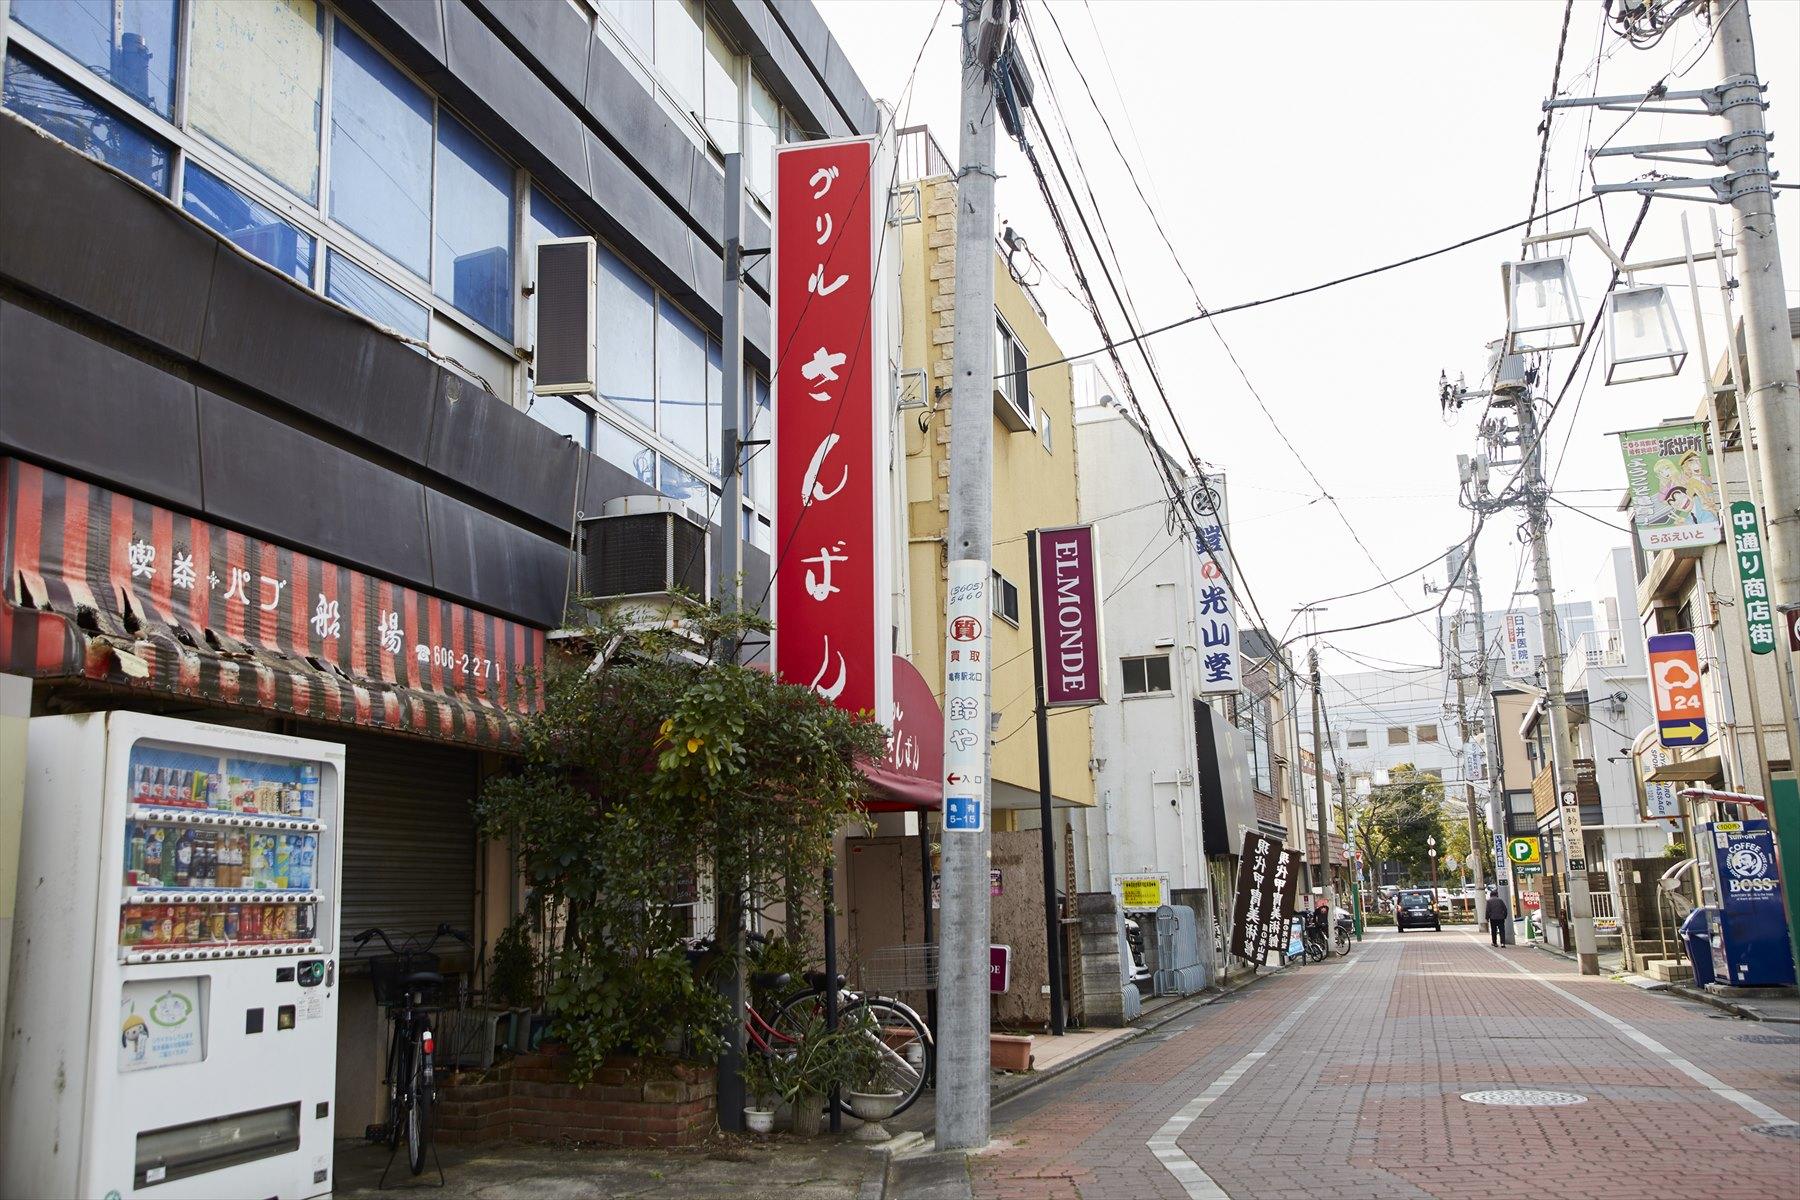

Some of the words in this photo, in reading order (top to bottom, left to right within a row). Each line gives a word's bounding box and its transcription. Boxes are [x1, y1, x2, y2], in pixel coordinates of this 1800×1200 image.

[808, 165, 850, 296] グリル
[1658, 435, 1703, 457] 派出所
[1650, 530, 1705, 544] らぶえいと
[128, 539, 197, 590] 喫茶
[223, 566, 288, 611] パブ
[1733, 509, 1774, 645] 中通り商店街
[950, 590, 983, 605] 5460
[310, 592, 404, 654] 船場
[1055, 539, 1086, 693] ELMONDE
[954, 619, 976, 641] 質
[433, 645, 500, 682] 606-2271
[950, 649, 981, 662] 買取
[948, 671, 983, 682] 亀有駅北口
[1674, 694, 1701, 710] 24
[949, 696, 979, 752] 鈴や
[961, 774, 982, 784] 入口
[1656, 782, 1666, 815] ASSAGE
[950, 803, 976, 813] 亀有
[949, 814, 976, 824] 5-15
[1567, 816, 1579, 835] 鈴や
[1514, 842, 1529, 860] P
[1728, 842, 1762, 854] COFFEE
[1729, 877, 1773, 892] BOSS
